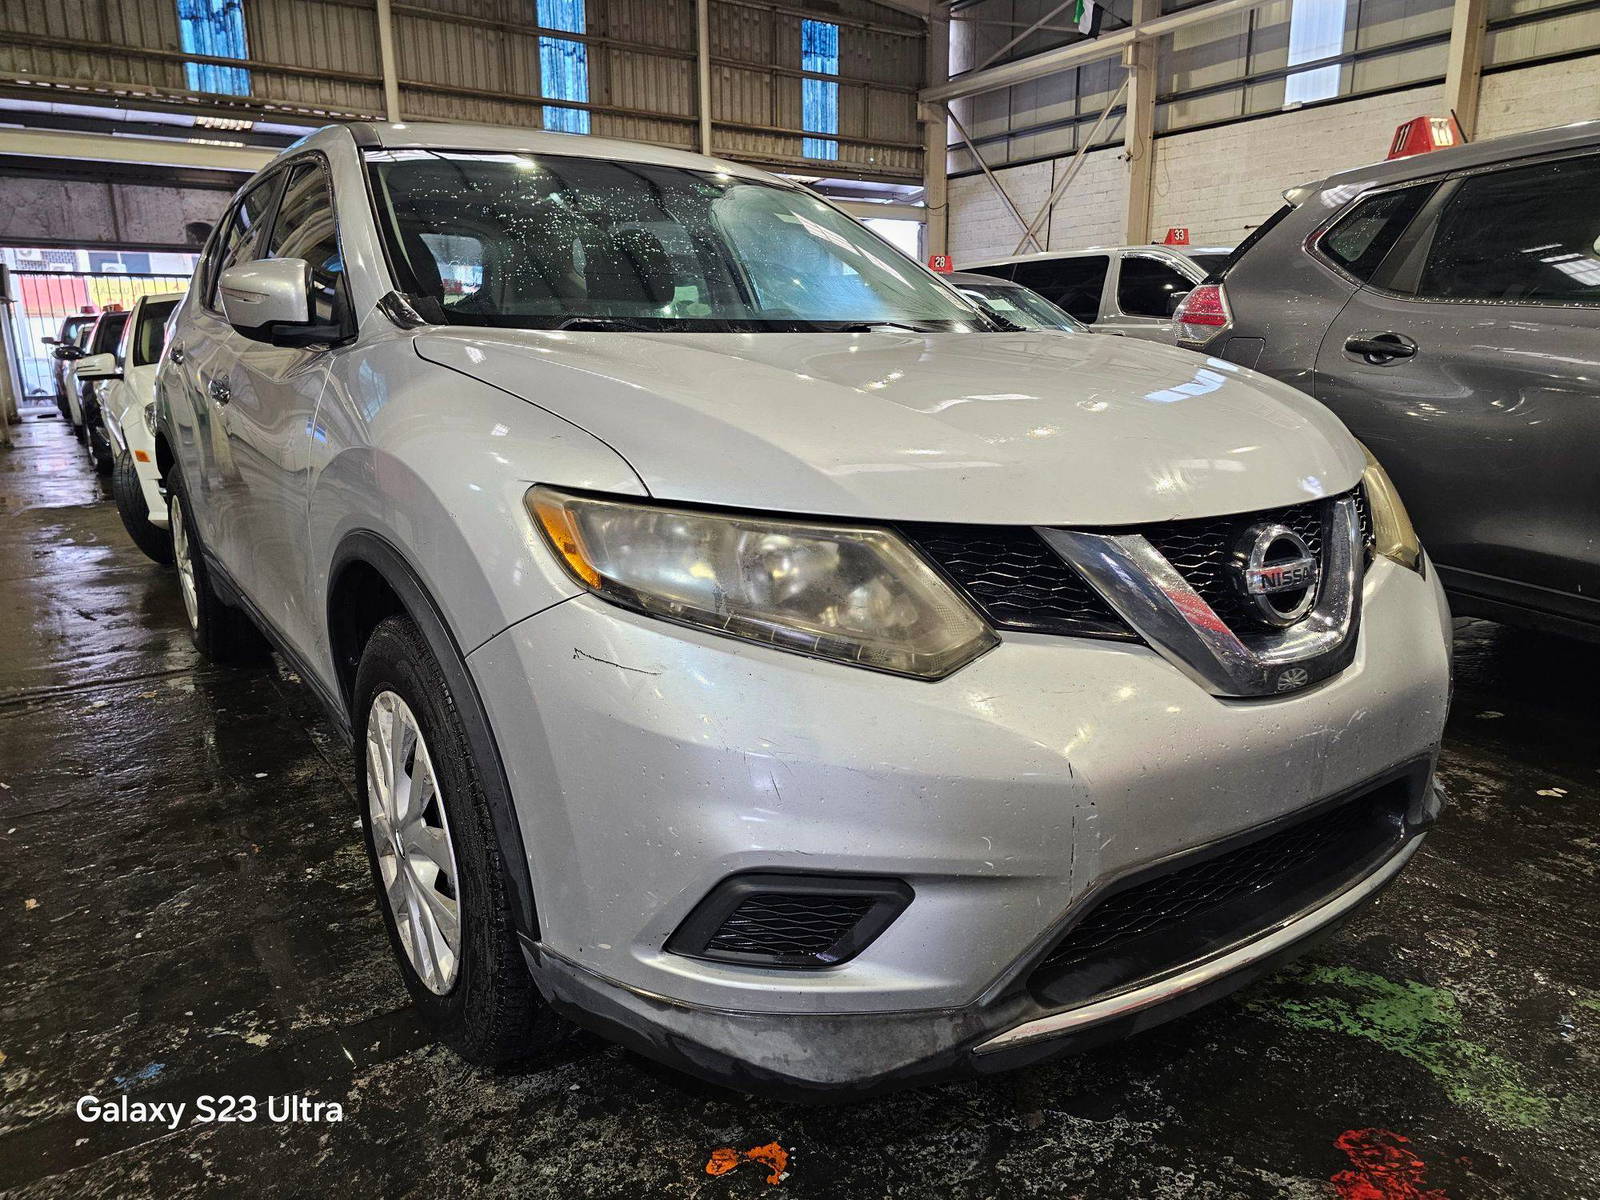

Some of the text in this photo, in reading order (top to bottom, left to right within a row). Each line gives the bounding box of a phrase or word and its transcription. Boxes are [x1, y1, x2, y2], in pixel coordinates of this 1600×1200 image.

[1174, 229, 1185, 241] 33
[934, 256, 946, 268] 28
[1260, 565, 1315, 590] NISSA
